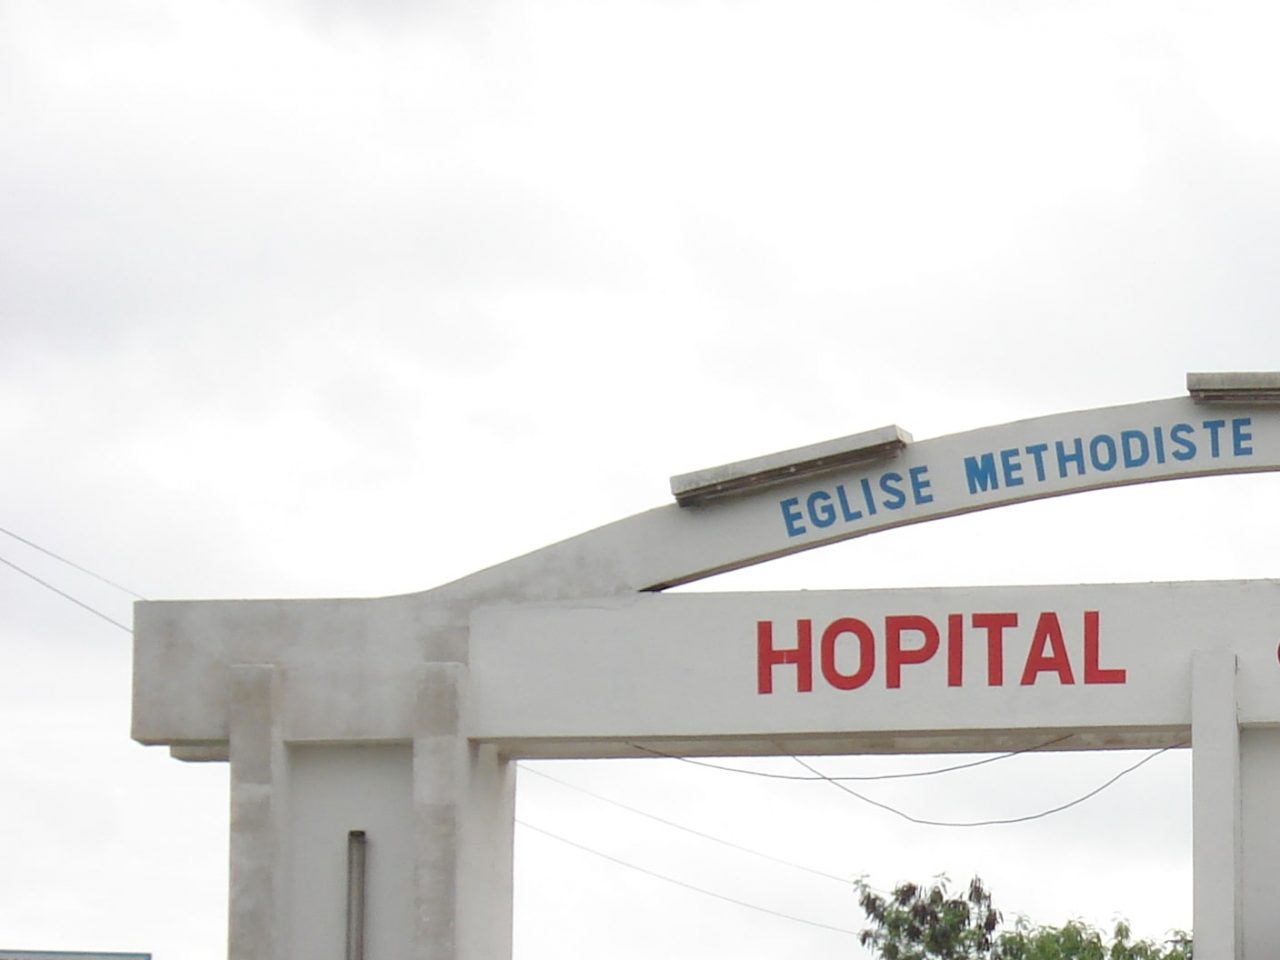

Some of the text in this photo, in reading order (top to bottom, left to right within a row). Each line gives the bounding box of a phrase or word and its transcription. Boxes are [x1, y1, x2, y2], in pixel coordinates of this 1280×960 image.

[780, 465, 933, 537] EGLISE
[964, 418, 1253, 495] METHODISTE
[756, 611, 1127, 694] HOPITAL
